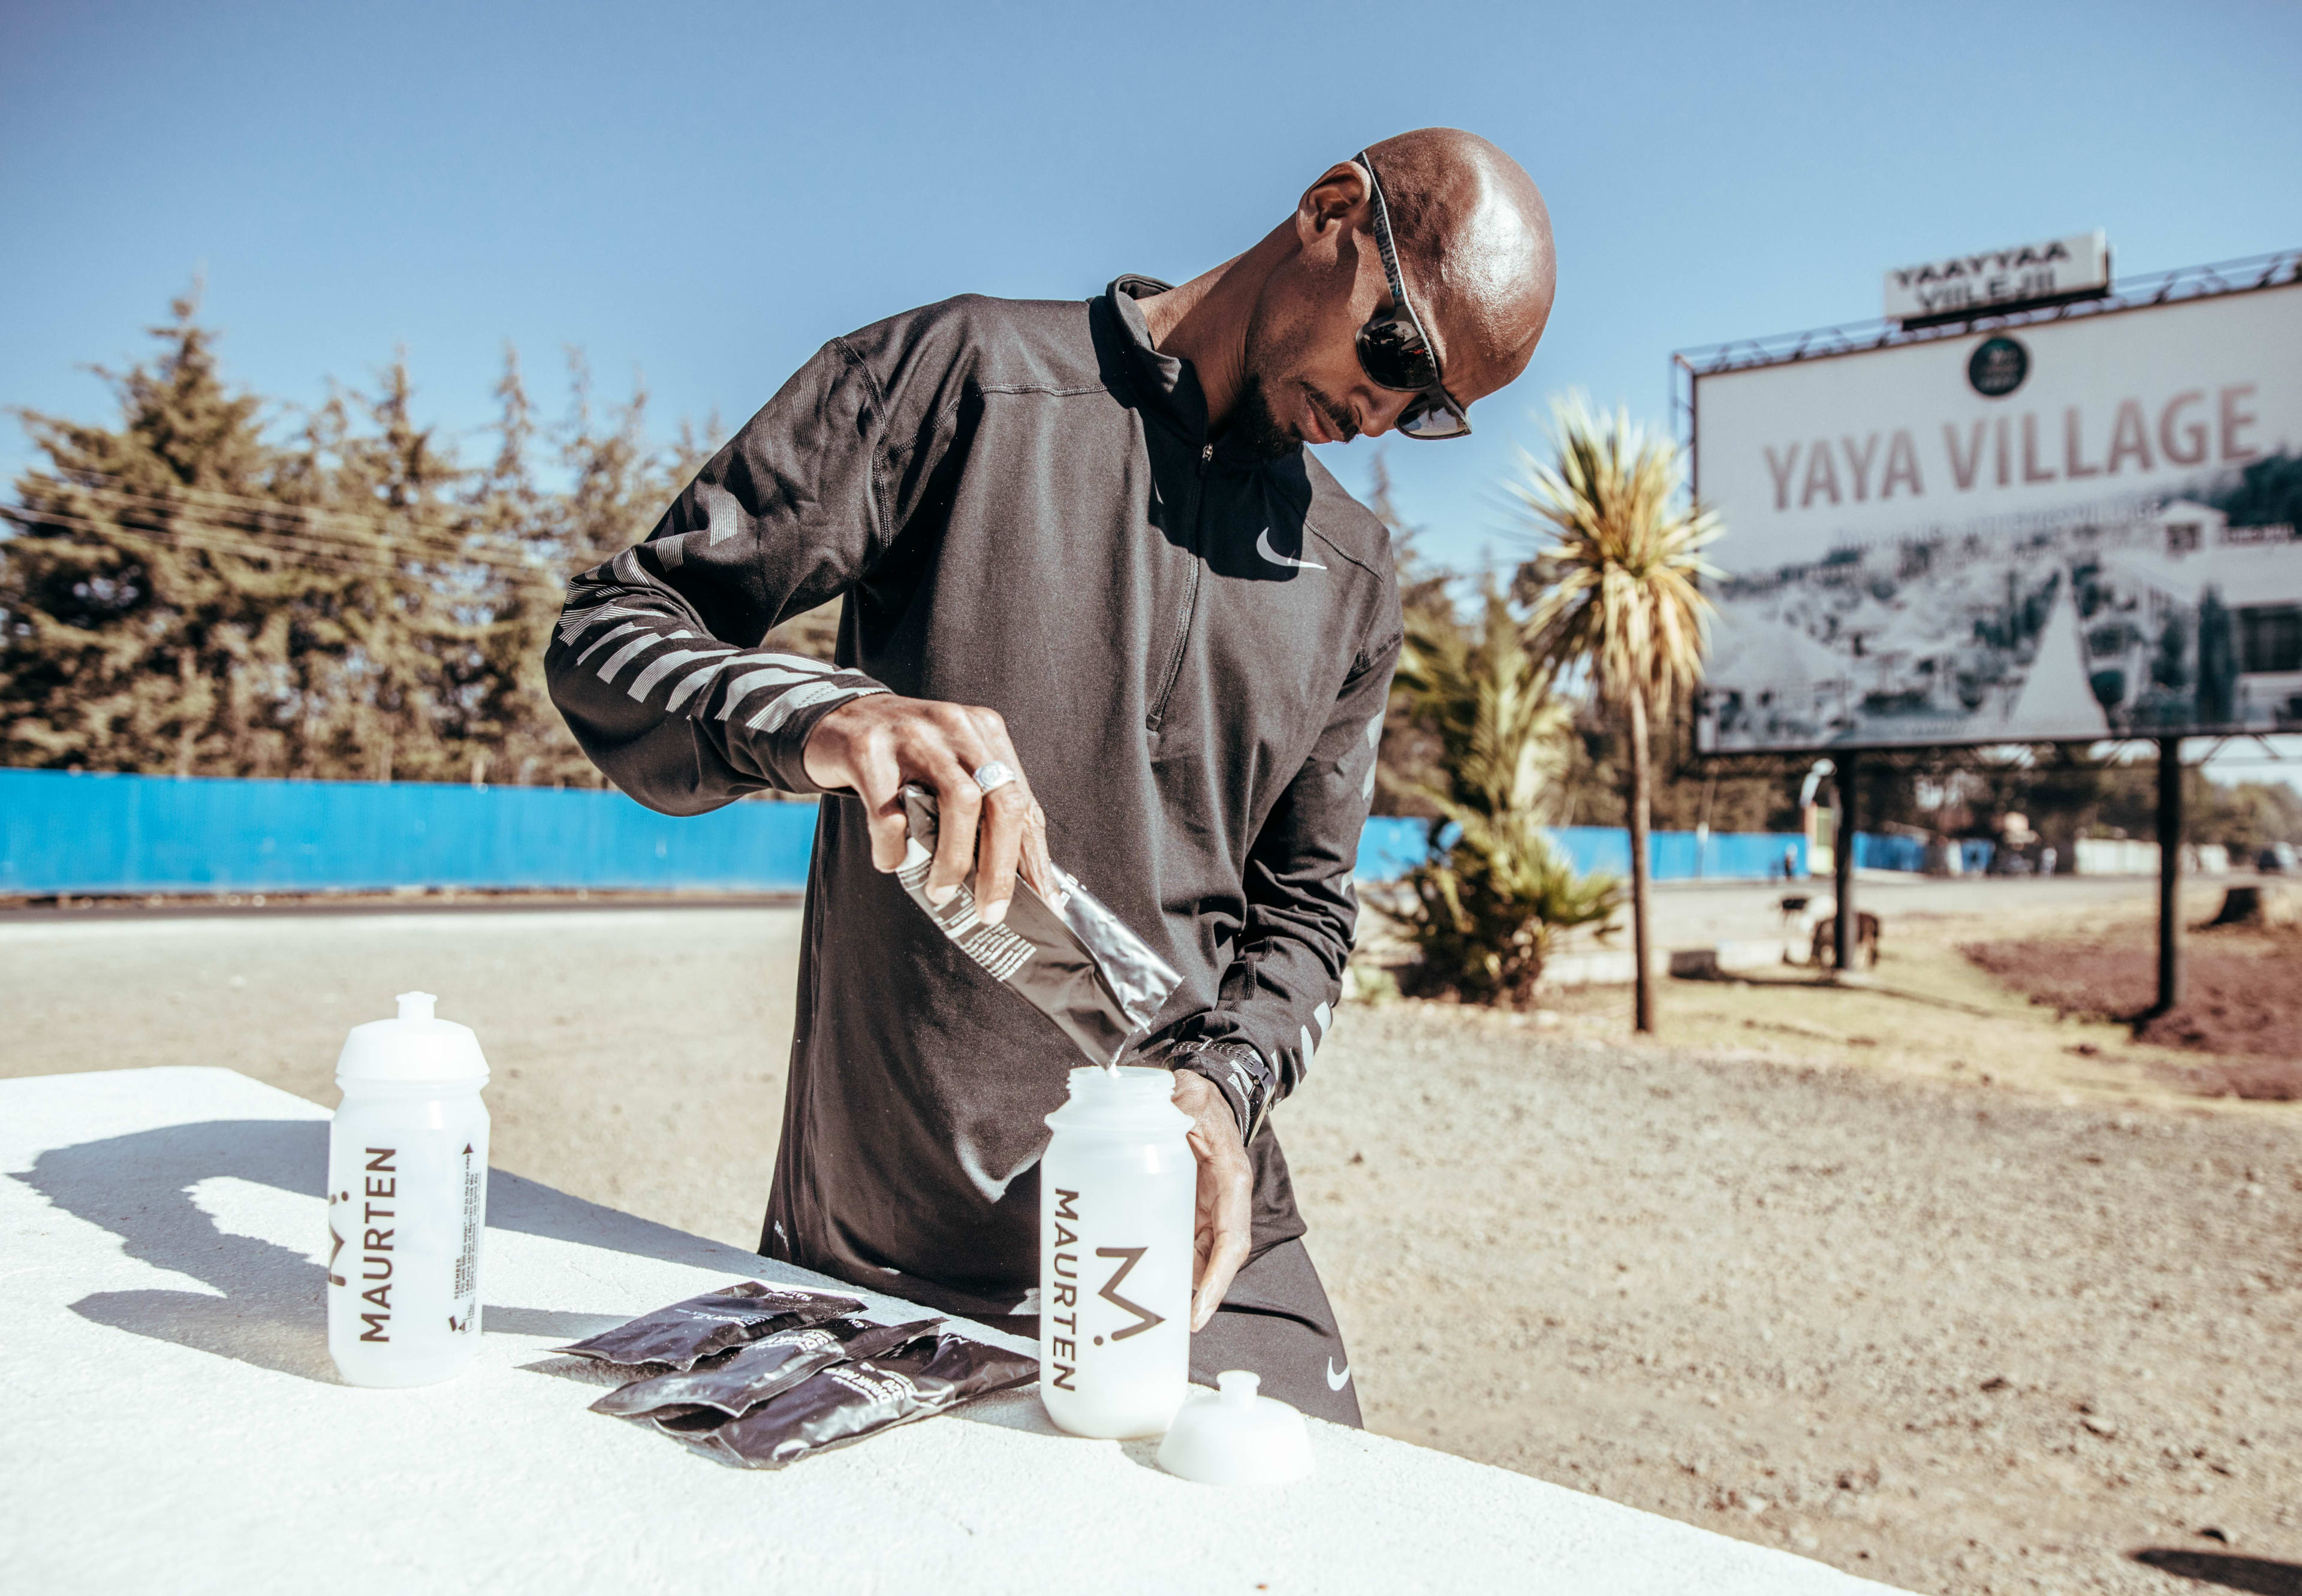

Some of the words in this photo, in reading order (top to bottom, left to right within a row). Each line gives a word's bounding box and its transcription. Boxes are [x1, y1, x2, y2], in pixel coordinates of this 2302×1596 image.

[1764, 428, 1925, 511] YAYA
[1942, 384, 2259, 490] VILLAGE
[360, 1147, 396, 1342] MAURTEN
[1053, 1187, 1079, 1392] MAURTEN
[881, 1379, 905, 1402] 320
